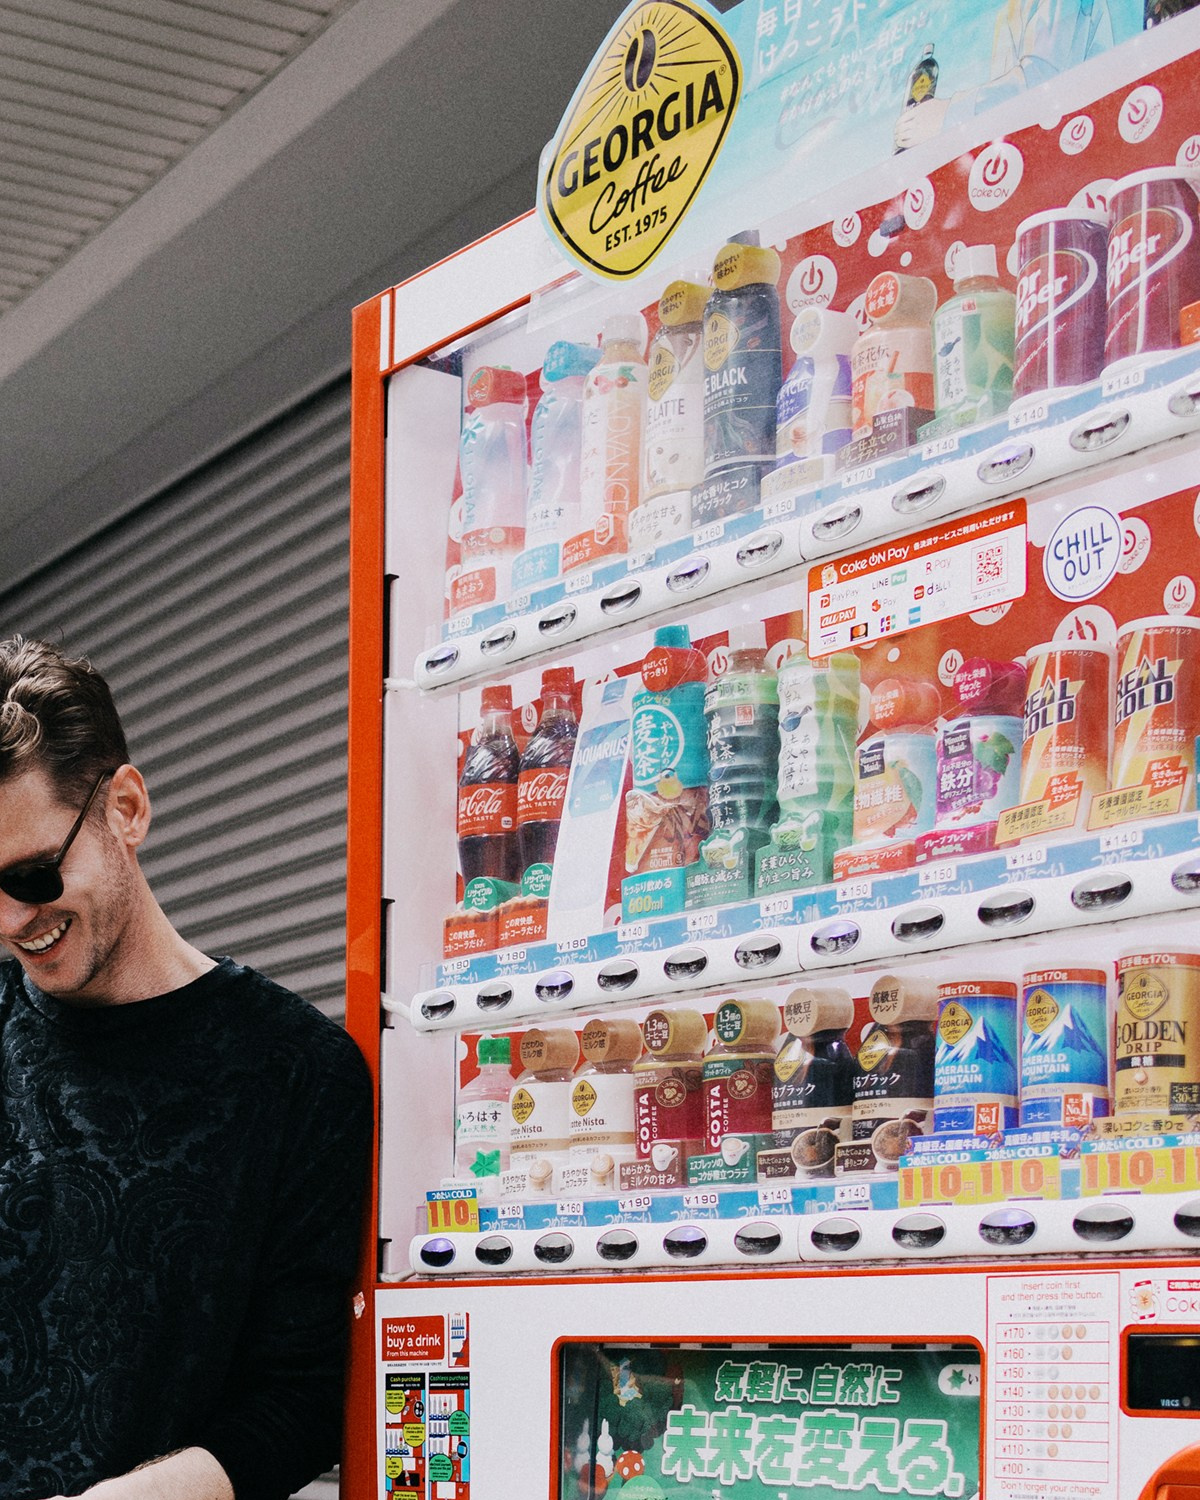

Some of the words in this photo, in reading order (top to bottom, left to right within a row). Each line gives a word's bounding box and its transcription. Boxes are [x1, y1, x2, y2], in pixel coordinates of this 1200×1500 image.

[557, 70, 725, 198] GEORGIA
[589, 153, 689, 235] Coffee
[971, 187, 993, 199] Coke
[993, 187, 1010, 199] ON
[634, 206, 668, 241] 1975
[710, 366, 748, 387] BLACK
[1105, 372, 1141, 392] ¥140
[654, 398, 685, 424] LATTE
[1013, 406, 1045, 424] ¥140
[926, 438, 955, 456] ¥140
[767, 501, 793, 516] ¥150
[1053, 521, 1113, 562] CHILL
[839, 558, 868, 577] Coke
[887, 545, 910, 563] Pay
[1063, 546, 1105, 583] OUT
[872, 577, 890, 591] LINE
[1116, 655, 1174, 699] REAL
[1025, 675, 1075, 720] REAL
[574, 737, 630, 766] AQUARIUS
[633, 711, 658, 778] 麦茶
[940, 769, 974, 793] 鉄分
[1104, 832, 1139, 847] ¥140
[1010, 849, 1043, 865] ¥140
[923, 867, 953, 882] ¥150
[840, 884, 869, 898] ¥150
[628, 895, 664, 914] 600ml
[765, 900, 789, 913] ¥170
[620, 926, 643, 938] ¥140
[557, 938, 588, 950] ¥180
[498, 951, 526, 962] ¥180
[442, 959, 470, 971] ¥180
[1126, 989, 1163, 1001] GEORGIA
[1125, 1041, 1162, 1055] DRIP
[709, 1085, 722, 1149] COSTA
[722, 1097, 730, 1133] COFFEE
[1027, 1111, 1050, 1120] コーヒー
[639, 1092, 651, 1154] COSTA
[651, 1105, 659, 1140] COFFEE
[940, 1119, 964, 1128] コーヒー
[1123, 1135, 1165, 1149] COLD
[936, 1152, 971, 1165] COLD
[1016, 1146, 1052, 1158] COLD
[451, 1189, 473, 1200] COLD
[683, 1194, 717, 1206] ¥190
[761, 1190, 788, 1202] ¥140
[559, 1203, 581, 1214] ¥160
[618, 1196, 651, 1209] ¥190
[500, 1206, 522, 1217] ¥160
[386, 1323, 405, 1334] How
[406, 1322, 416, 1333] to
[1003, 1327, 1025, 1340] ¥170
[386, 1336, 405, 1350] buy
[406, 1338, 414, 1347] a
[415, 1334, 441, 1347] drink
[1002, 1348, 1025, 1360] ¥160
[1002, 1367, 1024, 1379] ¥150
[714, 1360, 902, 1407] 気軽に、自然に
[1002, 1386, 1024, 1398] ¥140
[1002, 1405, 1024, 1418] ¥130
[1002, 1424, 1024, 1437] ¥120
[661, 1404, 965, 1498] 未来を変える。
[1002, 1443, 1024, 1455] ¥110
[1002, 1462, 1023, 1475] ¥100
